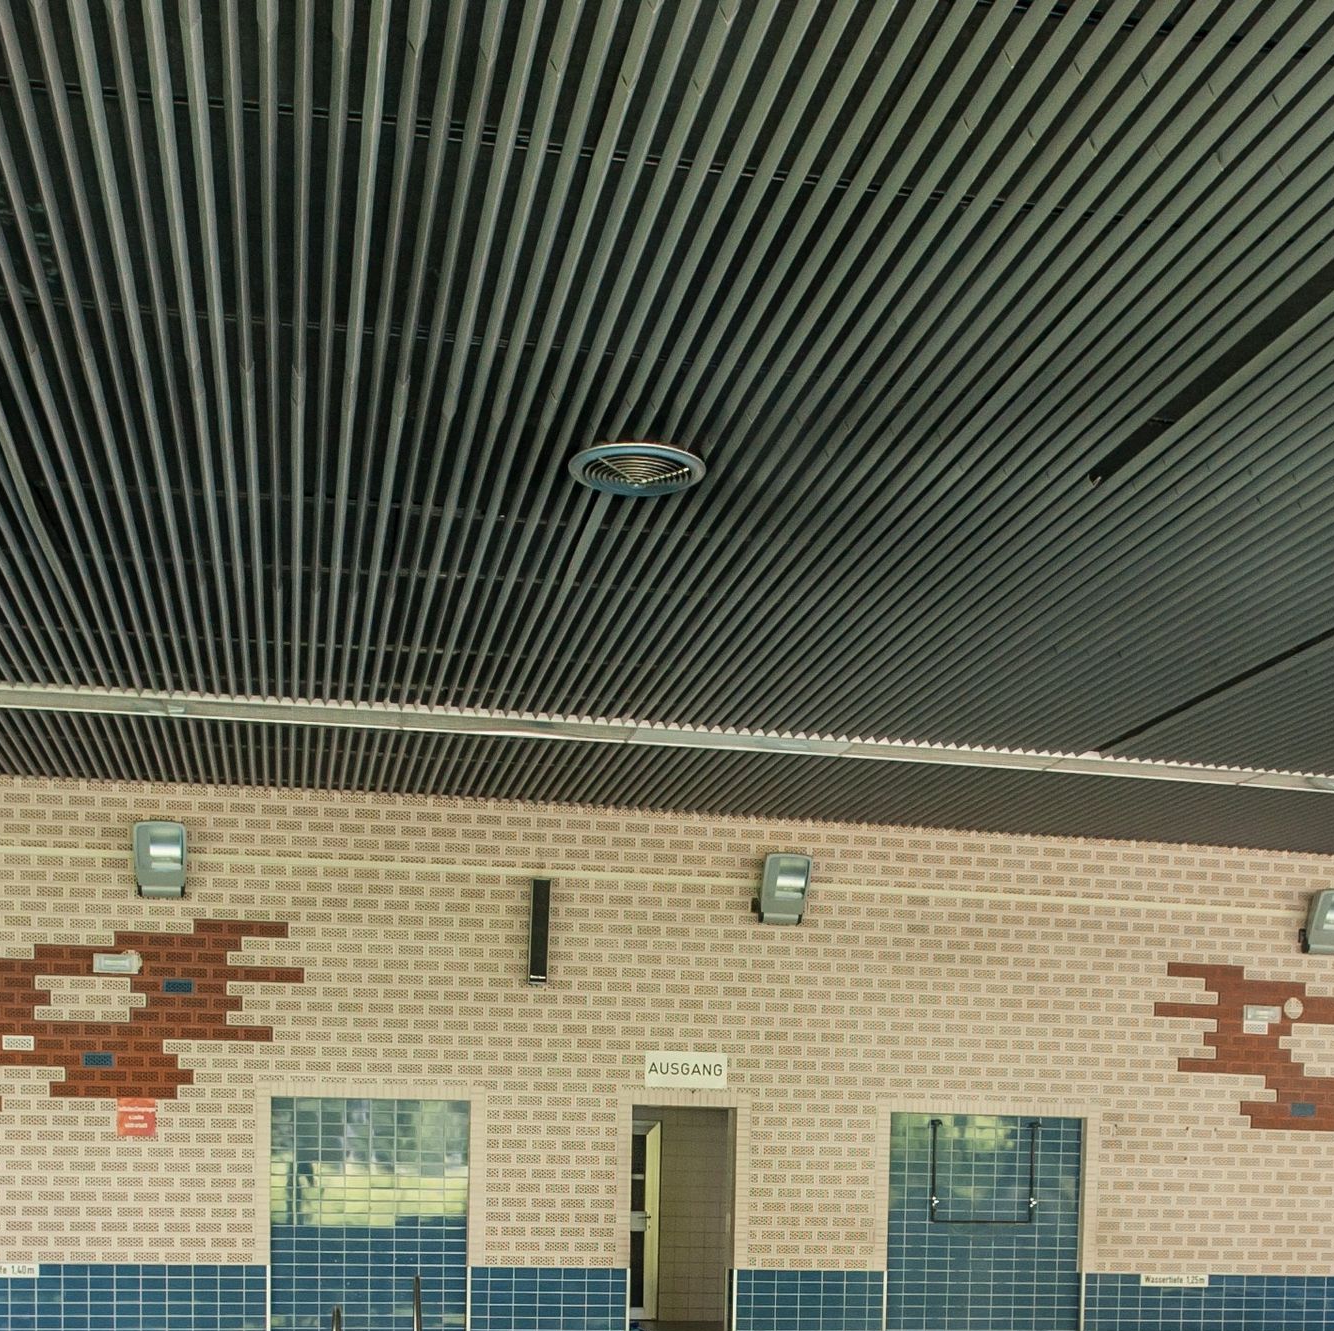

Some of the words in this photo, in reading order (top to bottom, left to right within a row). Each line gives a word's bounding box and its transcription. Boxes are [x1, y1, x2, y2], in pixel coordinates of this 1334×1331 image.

[648, 1062, 723, 1076] AUSGANG
[11, 1265, 35, 1275] 1,40m
[1144, 1275, 1183, 1284] Wassertiefe
